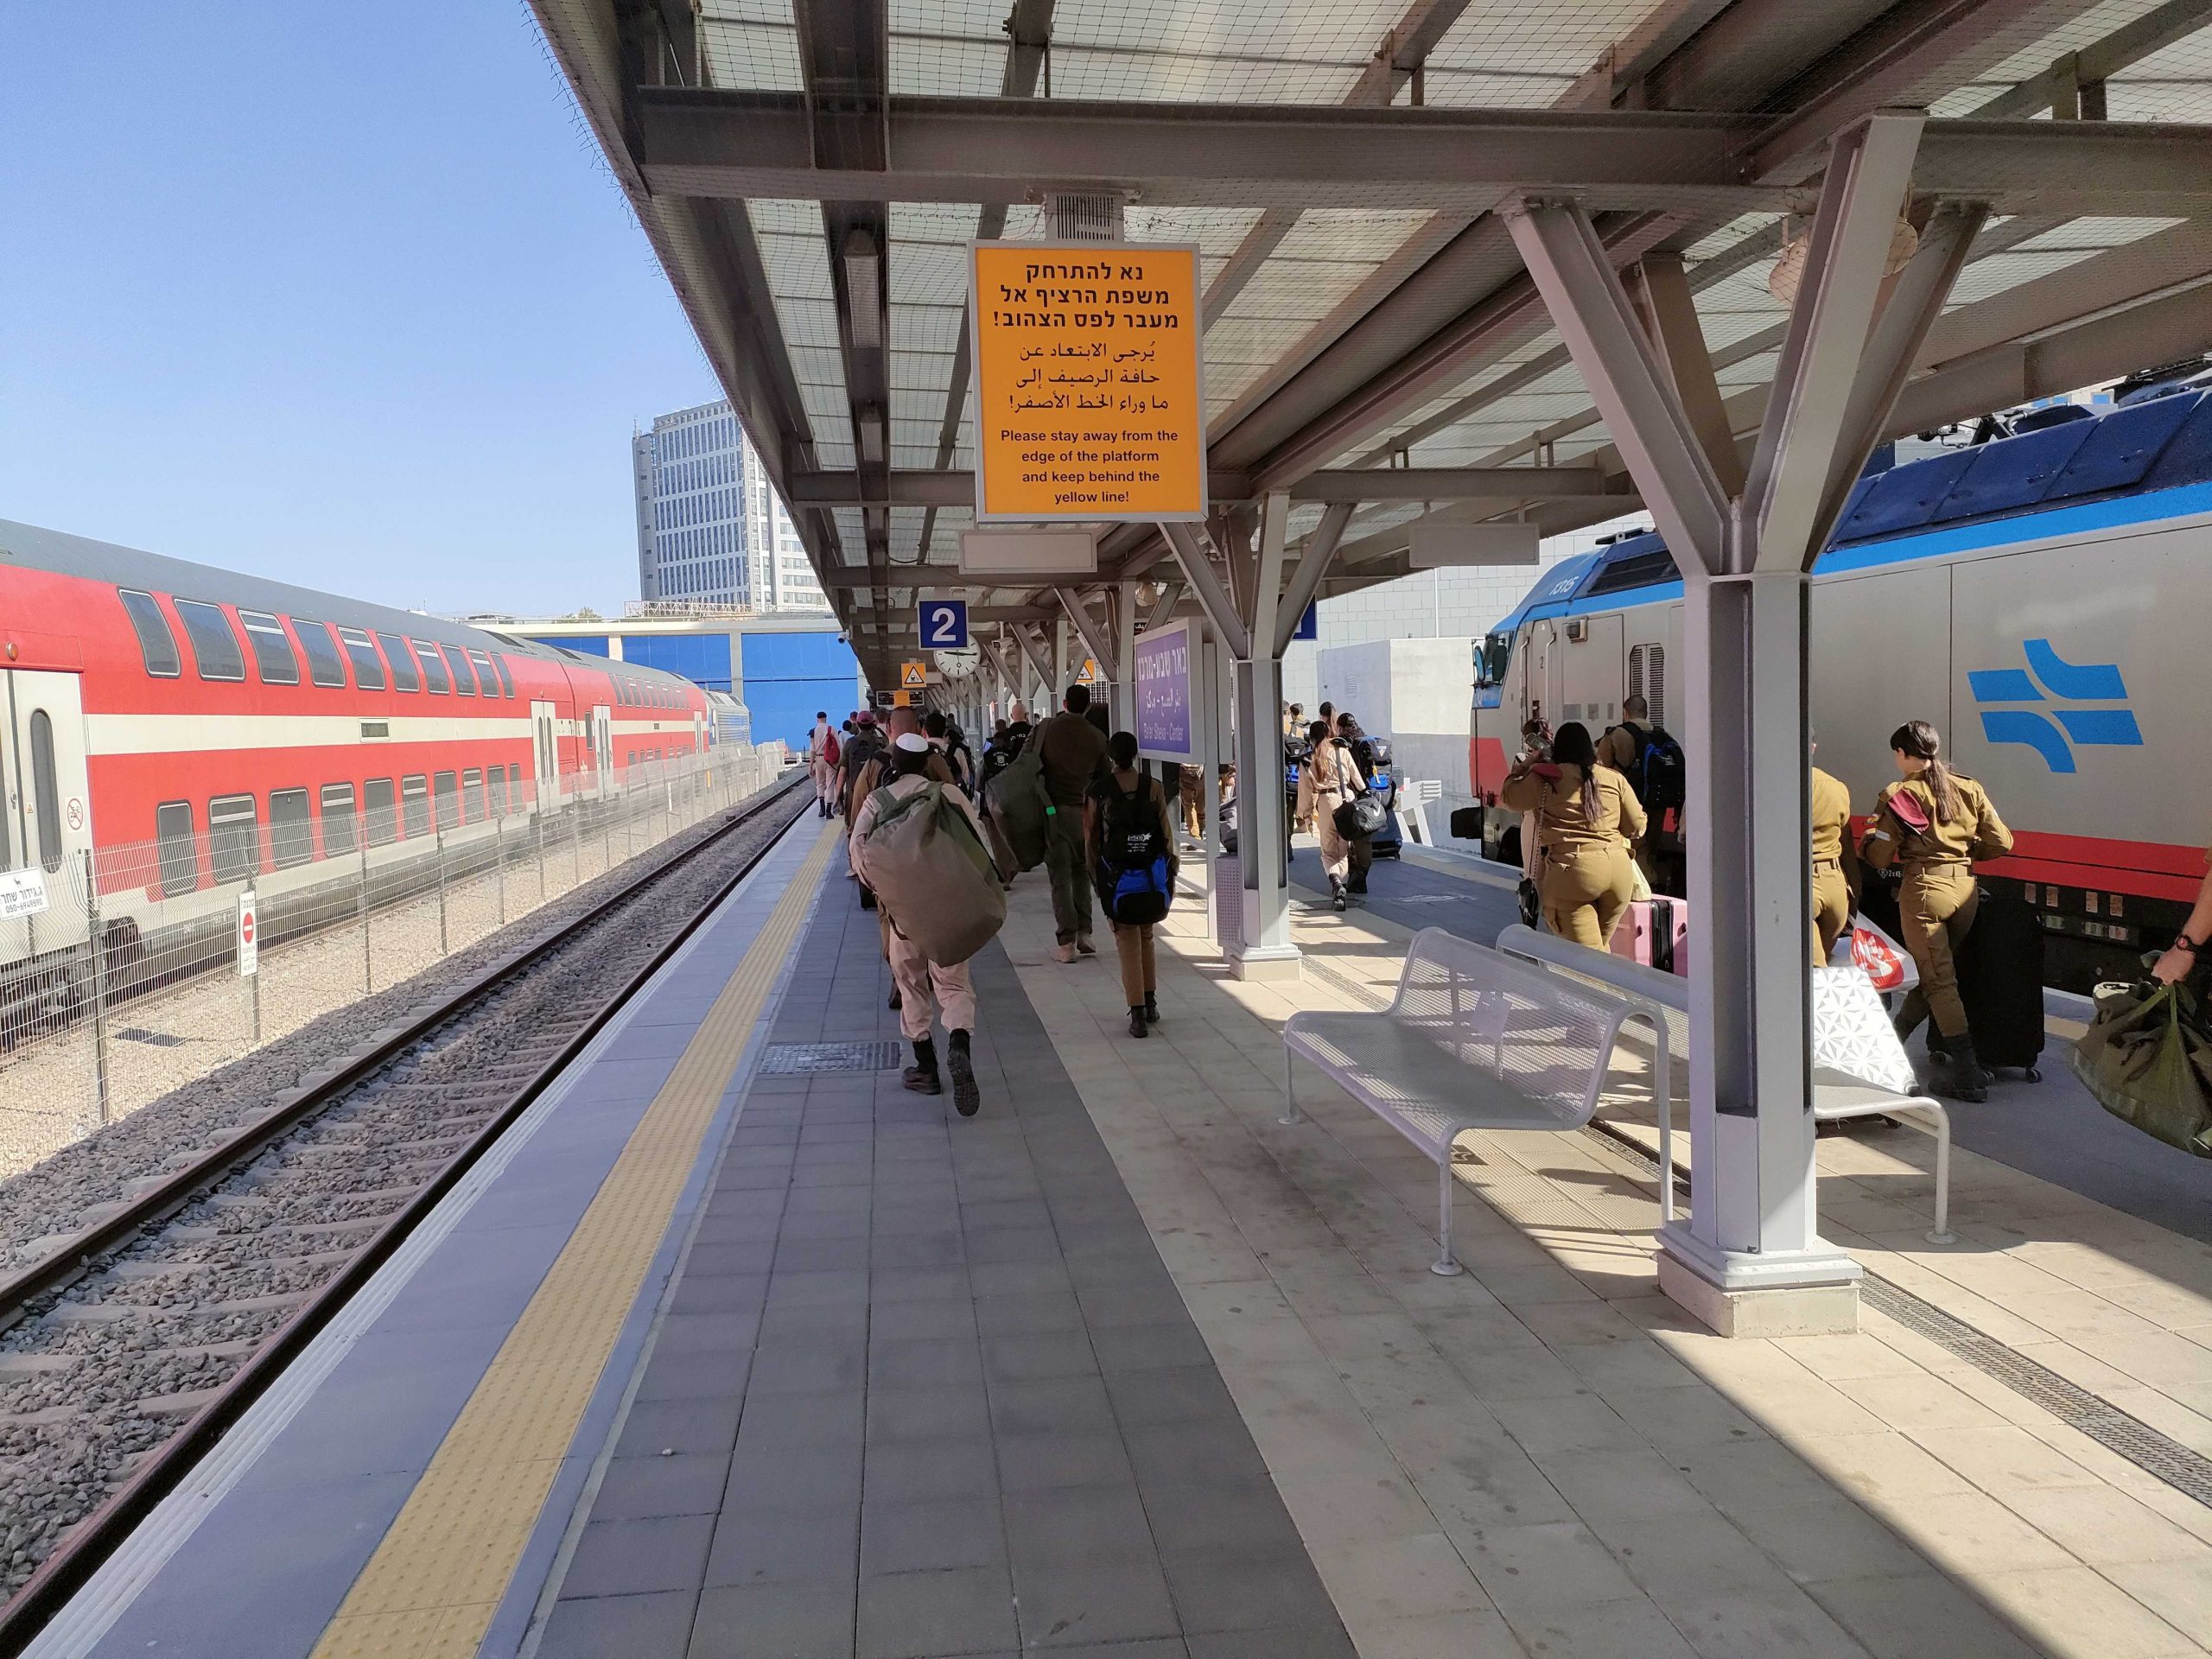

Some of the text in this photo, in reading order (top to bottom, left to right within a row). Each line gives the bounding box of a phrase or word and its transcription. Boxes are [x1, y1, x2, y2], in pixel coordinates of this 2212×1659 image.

[1026, 262, 1143, 283] נא להתרחק
[1000, 284, 1169, 308] משפת הרציף אל
[993, 309, 1179, 329] מעבר לפס הצהוב!
[1020, 346, 1045, 362] عن
[1050, 342, 1107, 362] الابتعاد
[1015, 367, 1160, 390] حافة الرصيف إلى
[1009, 389, 1169, 414] ما وراء الخط الأصفر!
[1001, 429, 1179, 444] Please stay away from the
[1021, 450, 1160, 464] edge of the platform
[1022, 470, 1160, 485] and keep behind the
[1054, 491, 1129, 505] yellow line!
[1548, 575, 1580, 596] 1315
[931, 607, 957, 642] 2
[1172, 646, 1187, 676] באר
[1, 892, 17, 904] שחר
